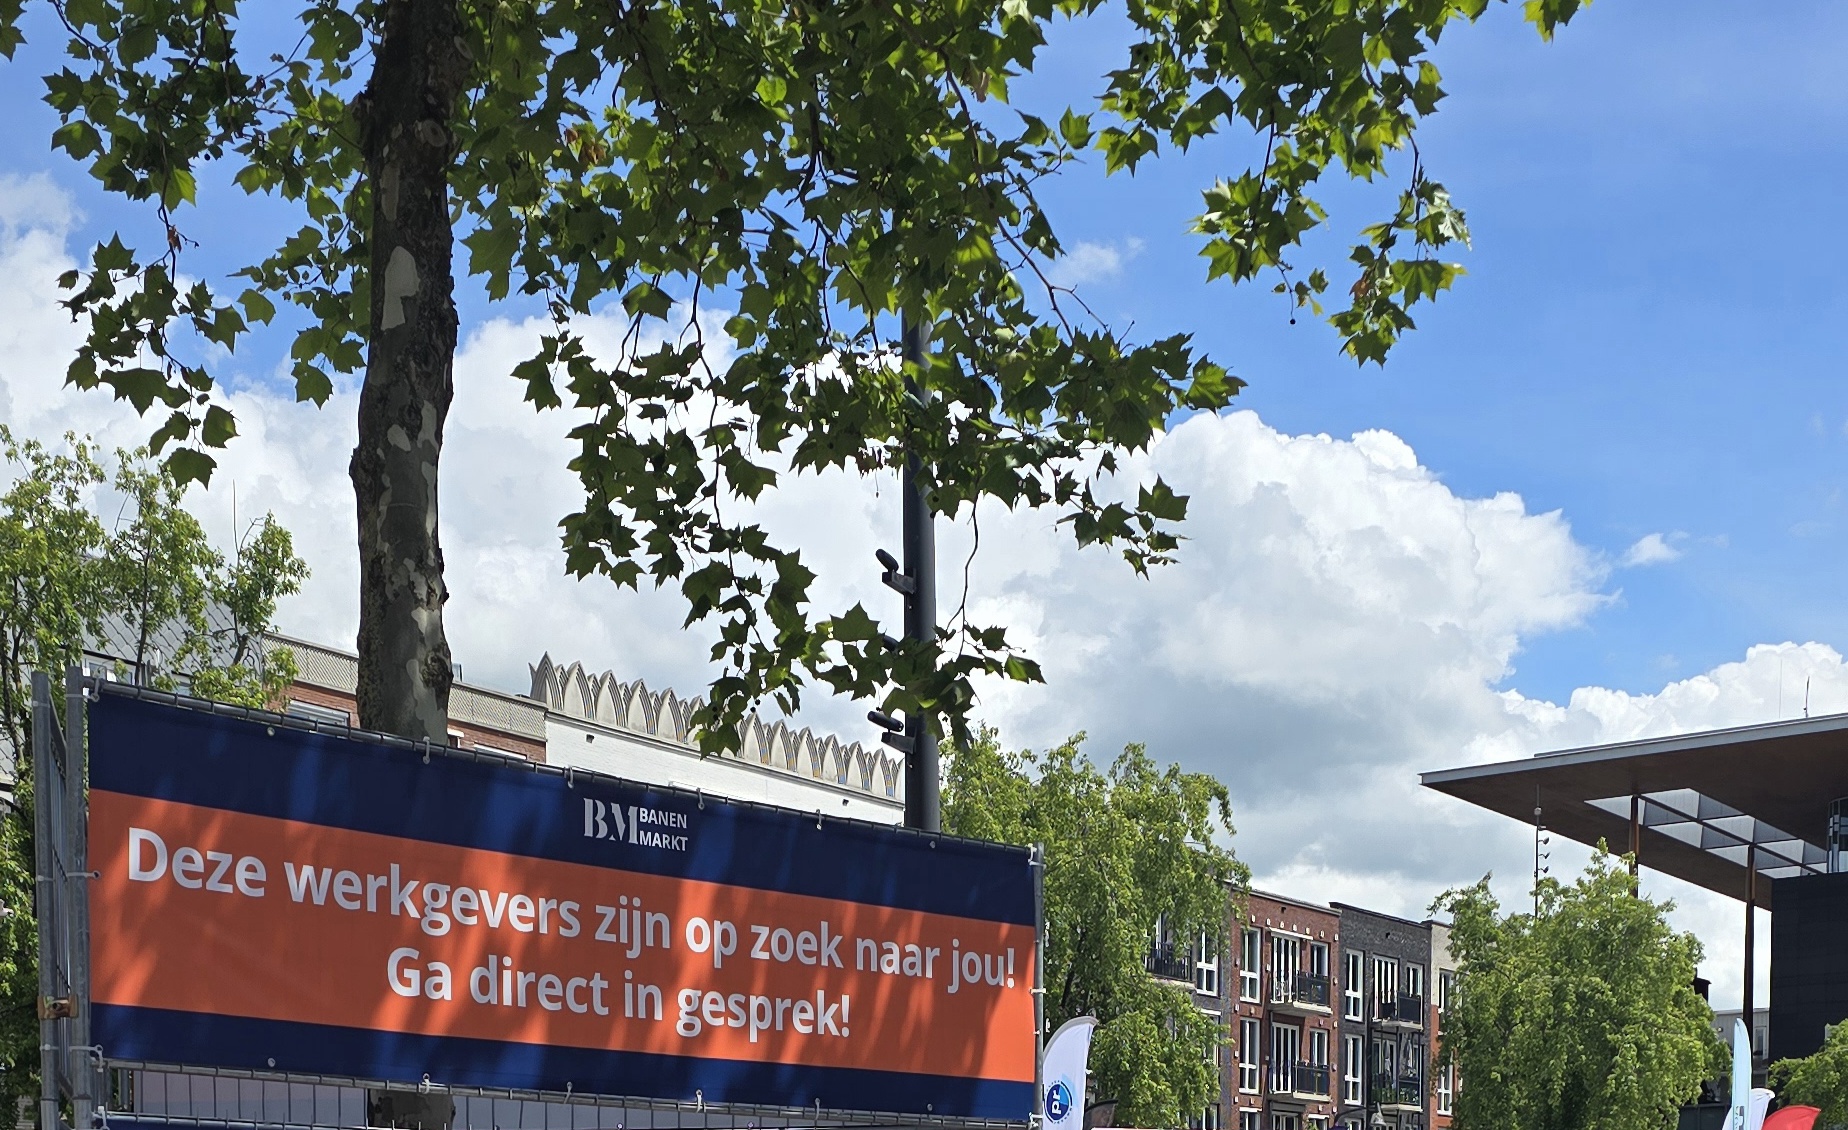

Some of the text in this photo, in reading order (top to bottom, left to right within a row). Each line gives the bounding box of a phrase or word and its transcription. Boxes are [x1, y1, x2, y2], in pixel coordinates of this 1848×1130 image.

[584, 798, 638, 844] BM
[640, 808, 686, 828] BANEN
[640, 831, 687, 850] MARKT
[129, 827, 1014, 993] Deze werkgevers zijn op zoek naar jou!
[388, 948, 849, 1042] Ga direct in gesprek!
[1051, 1089, 1062, 1115] pr
